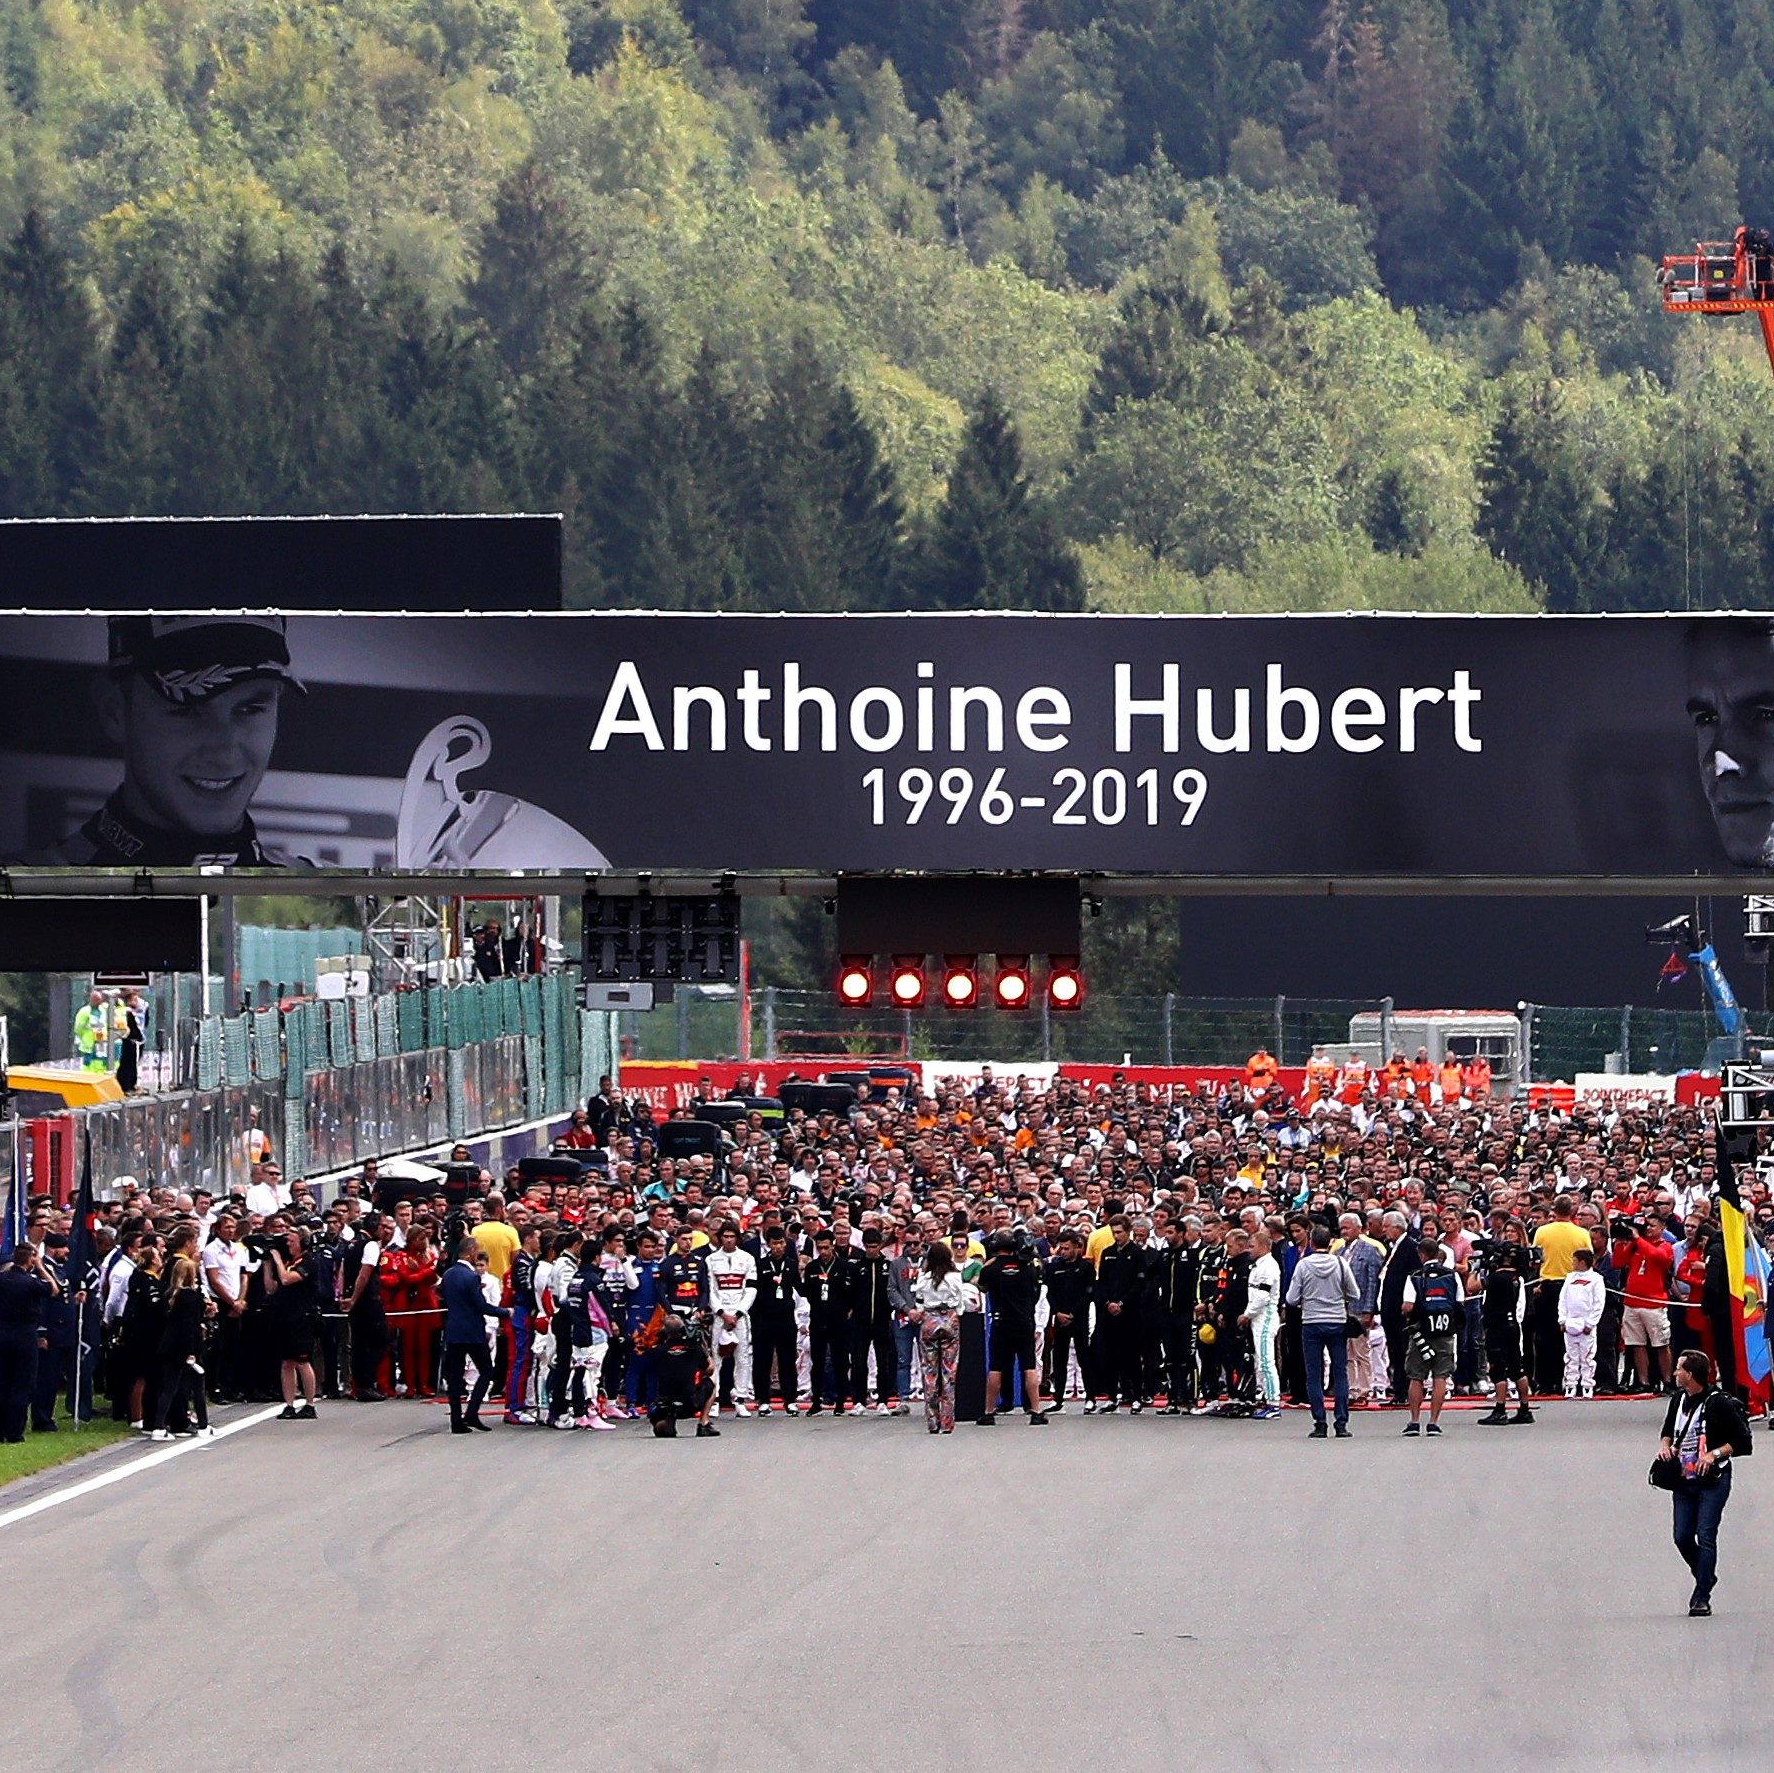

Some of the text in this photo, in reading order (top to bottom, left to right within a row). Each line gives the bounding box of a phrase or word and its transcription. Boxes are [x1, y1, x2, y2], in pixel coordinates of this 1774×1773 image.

[589, 661, 1482, 753] Anthoine Hubert
[862, 767, 1207, 826] 1996-2019
[1428, 1313, 1450, 1332] 149
